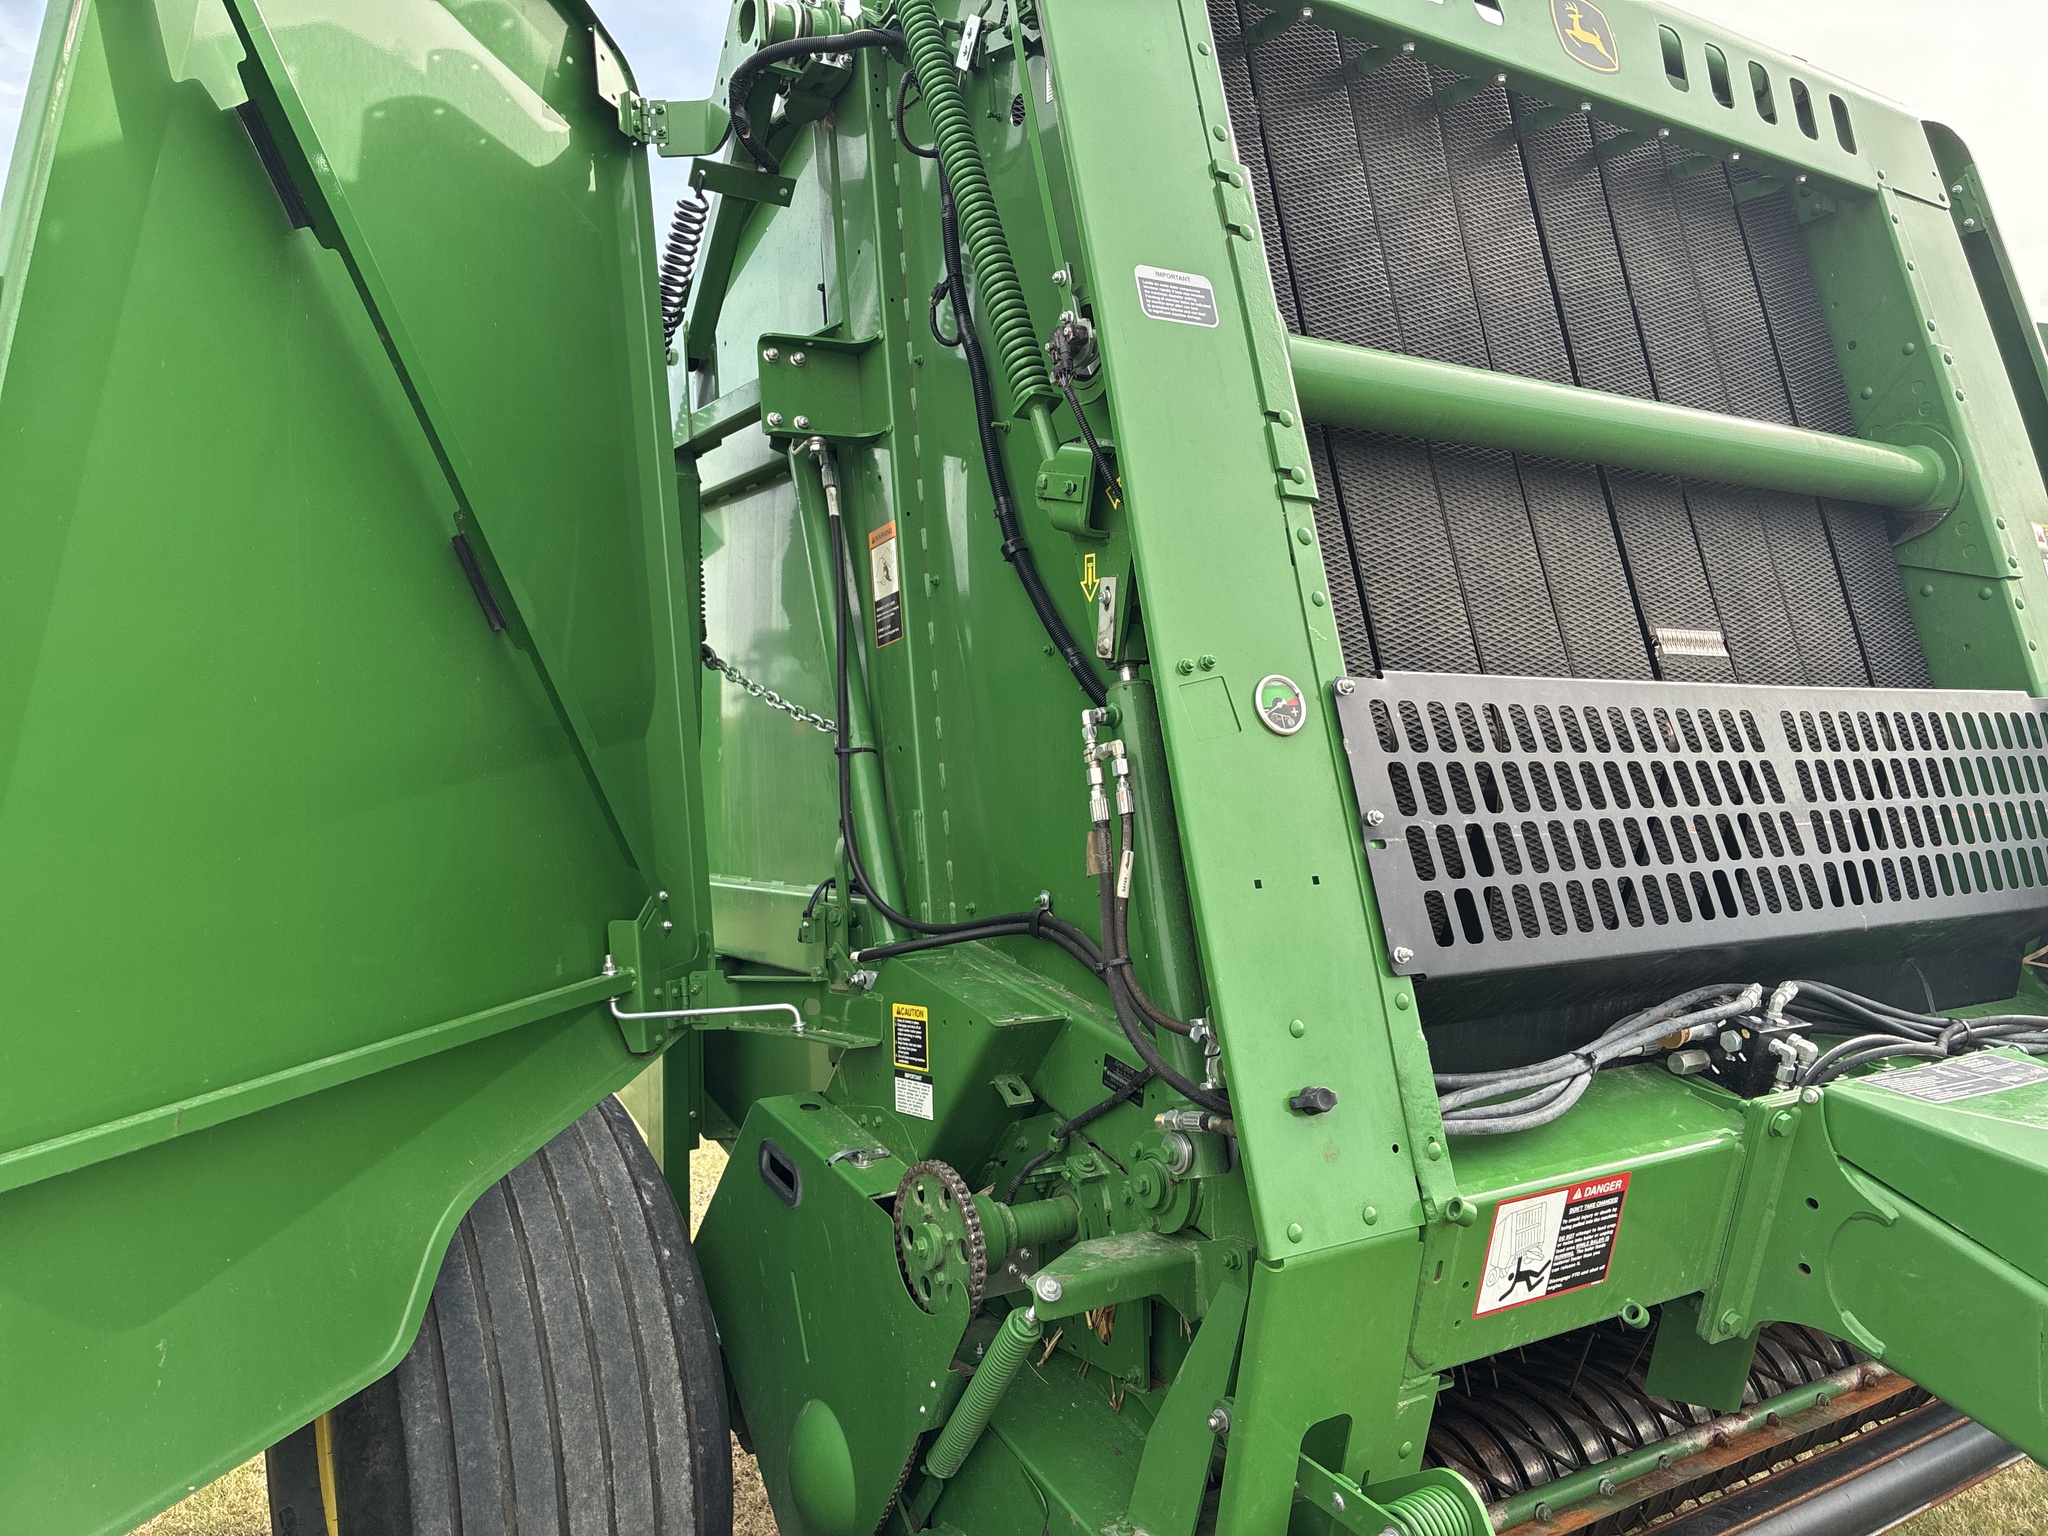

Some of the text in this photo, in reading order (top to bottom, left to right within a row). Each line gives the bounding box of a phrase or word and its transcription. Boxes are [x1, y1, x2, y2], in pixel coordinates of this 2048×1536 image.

[1155, 271, 1190, 282] IMPORTANT
[875, 528, 893, 541] WARNING
[900, 1007, 924, 1018] CAUTION
[1584, 1180, 1622, 1197] DANGER
[1569, 1205, 1584, 1215] DON'T
[1584, 1202, 1596, 1211] TAKE
